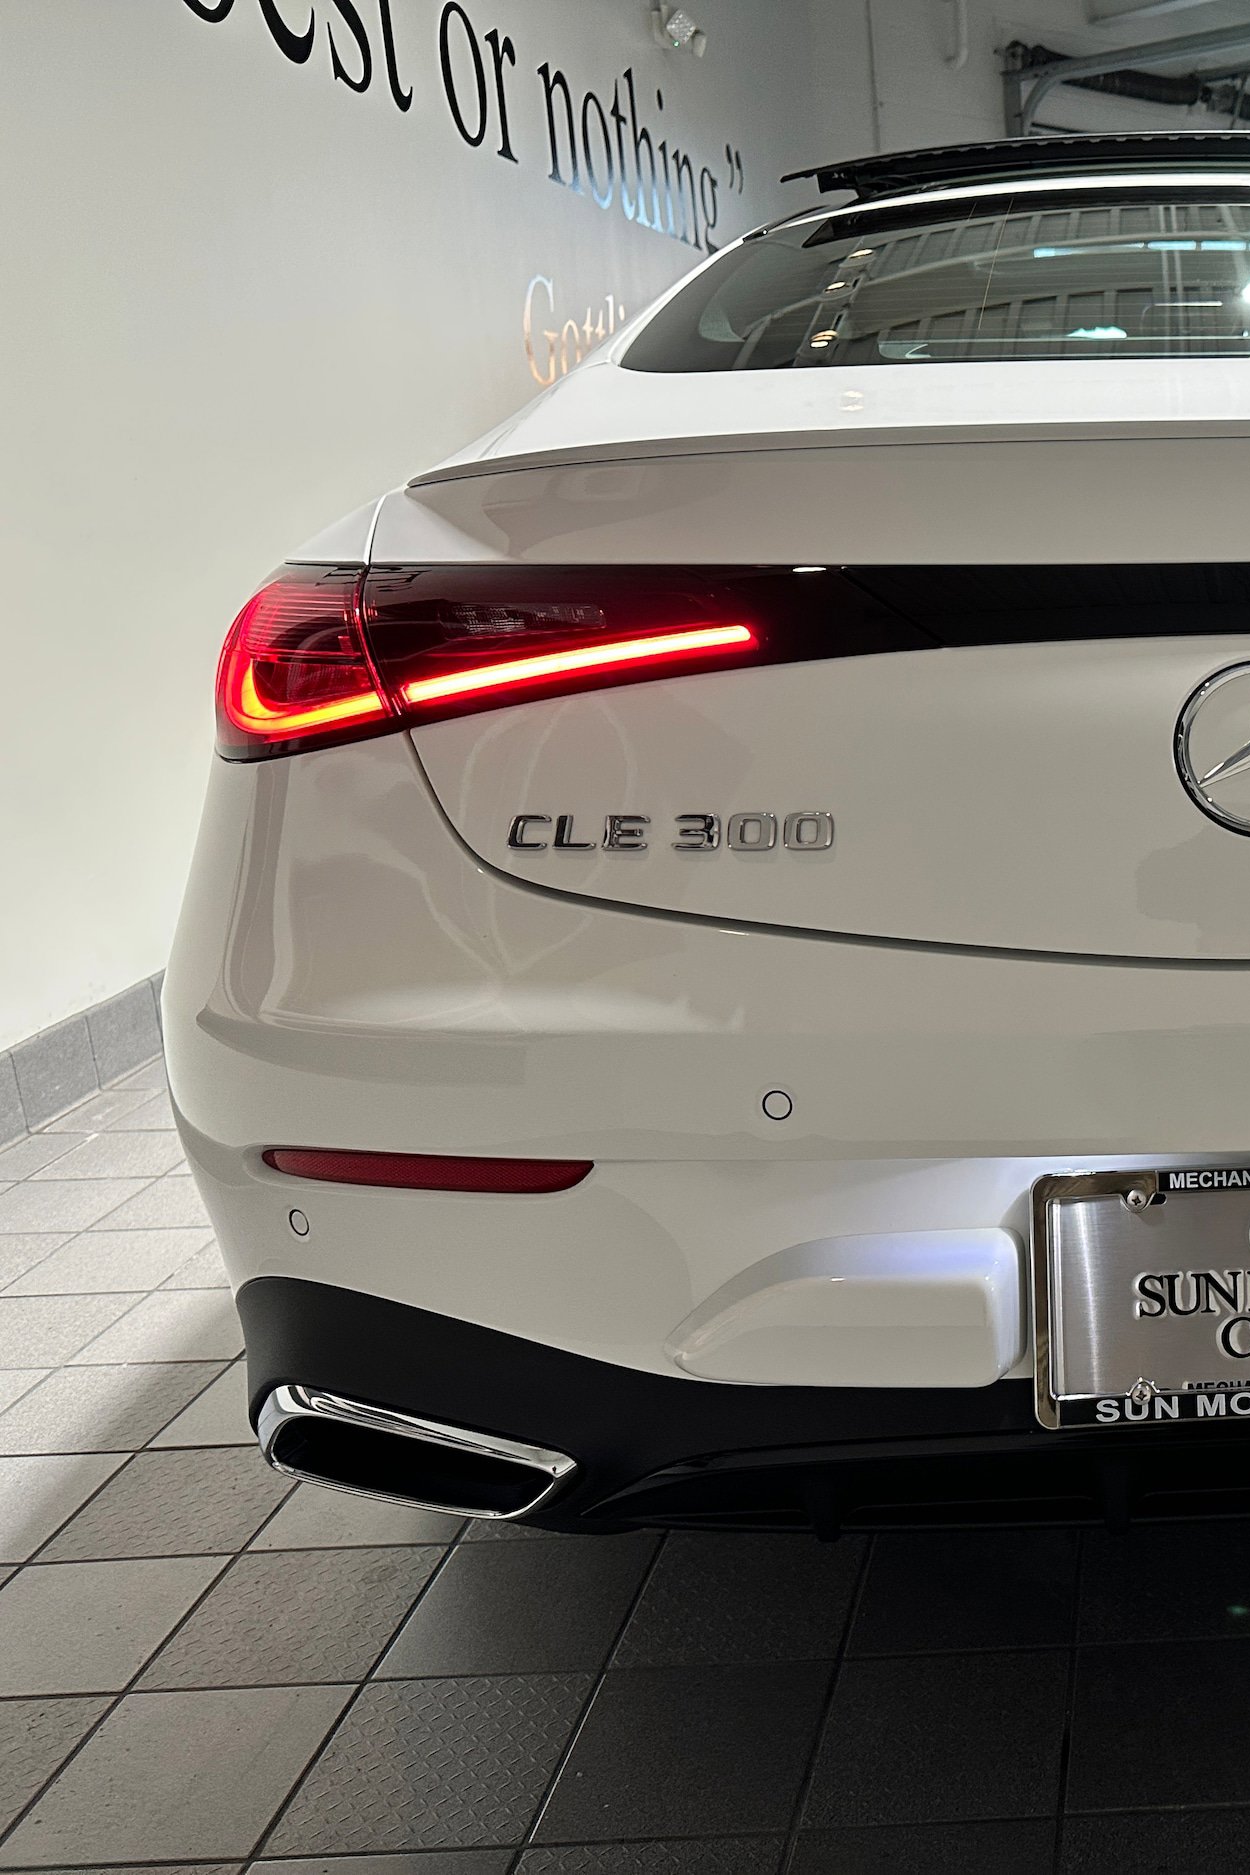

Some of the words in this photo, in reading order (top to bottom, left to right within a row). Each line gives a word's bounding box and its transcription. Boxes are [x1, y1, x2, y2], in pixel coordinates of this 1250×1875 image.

[439, 1, 519, 164] or
[506, 815, 651, 851] CLE
[671, 812, 836, 851] 300
[1096, 1396, 1179, 1423] SUN
